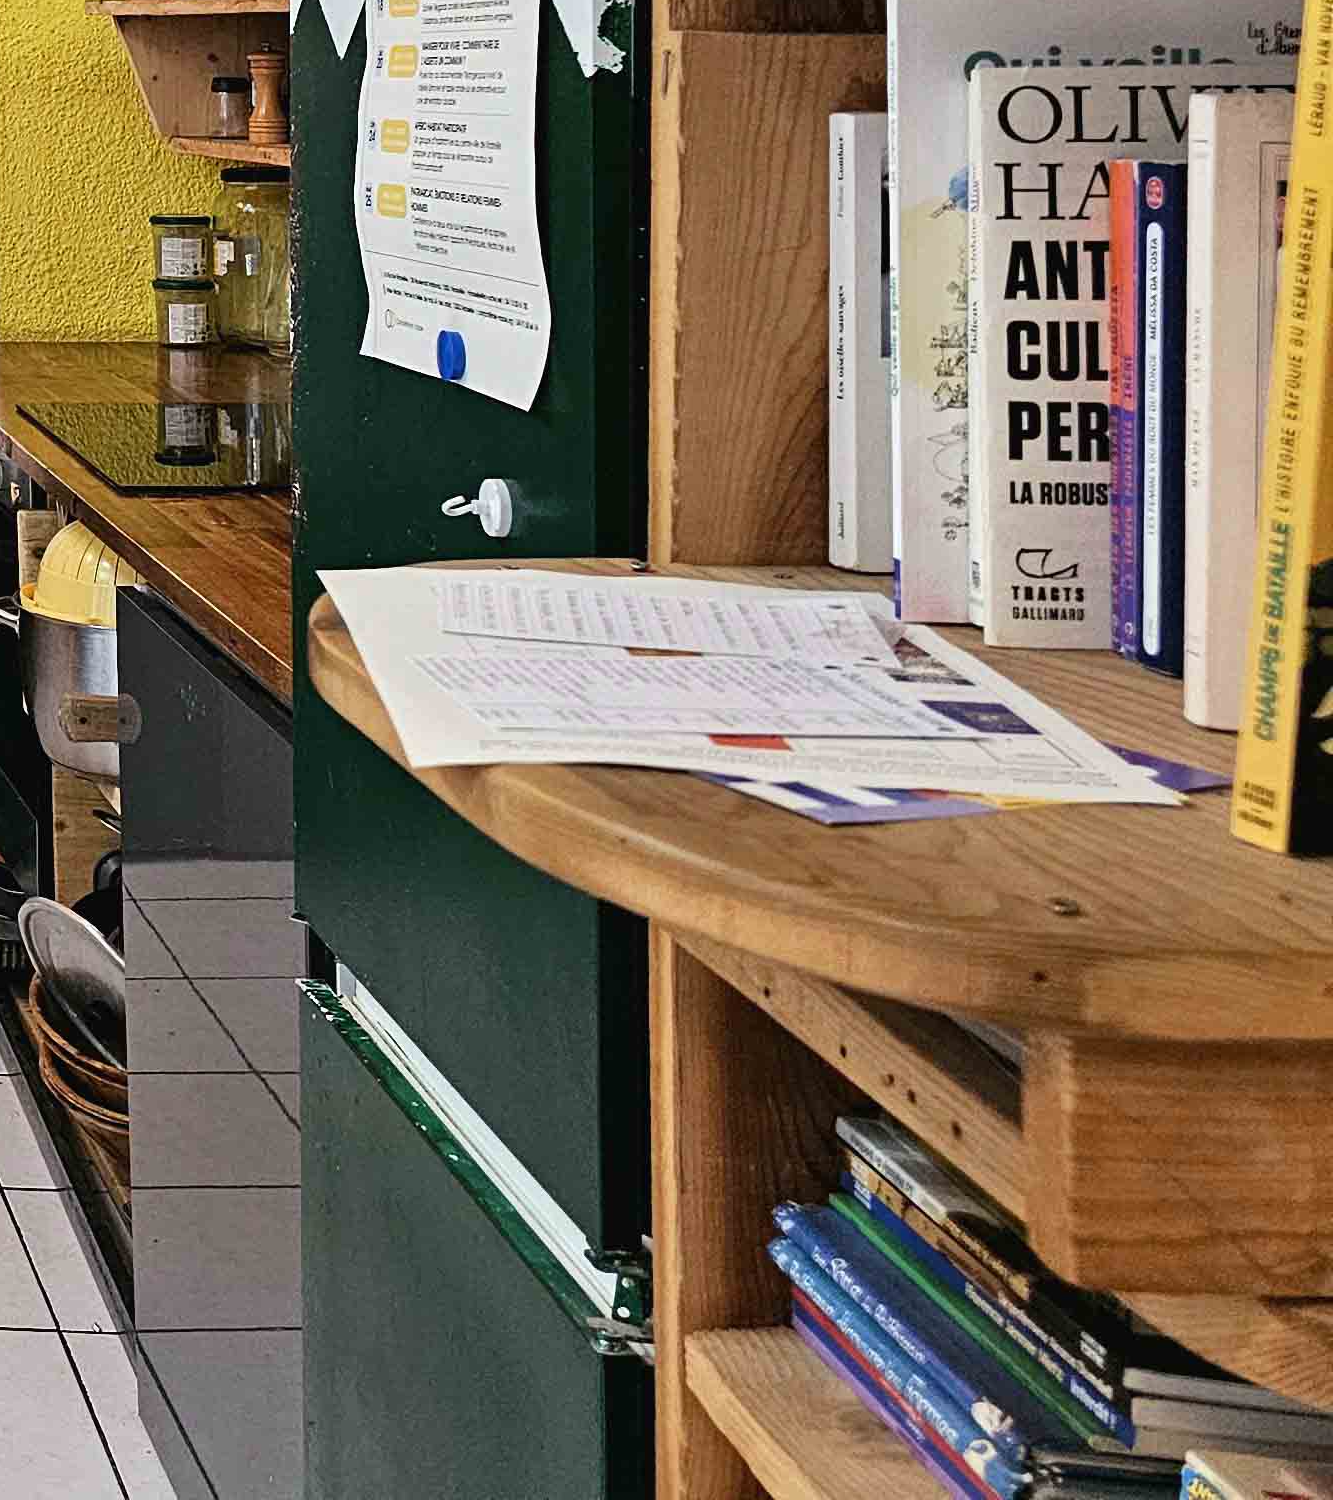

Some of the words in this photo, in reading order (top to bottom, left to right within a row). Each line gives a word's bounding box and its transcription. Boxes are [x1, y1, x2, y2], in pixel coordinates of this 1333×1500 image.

[1316, 40, 1331, 66] VAN
[1309, 83, 1326, 138] LÉRAUD
[1151, 237, 1160, 273] COSTA
[1291, 186, 1319, 324] REMEMBREMENT
[1151, 275, 1160, 292] DA
[836, 285, 847, 334] sauvages
[1150, 294, 1159, 340] MÉLISSA
[836, 380, 845, 400] Les
[1282, 353, 1304, 421] ENFOUIE
[1009, 480, 1032, 505] LA
[1275, 426, 1296, 514] L'HISTOIRE
[1012, 585, 1086, 602] TRACTS
[1263, 522, 1290, 621] BATAILLE
[1012, 606, 1086, 622] GALLIMARD
[1253, 646, 1280, 742] CHAMPS
